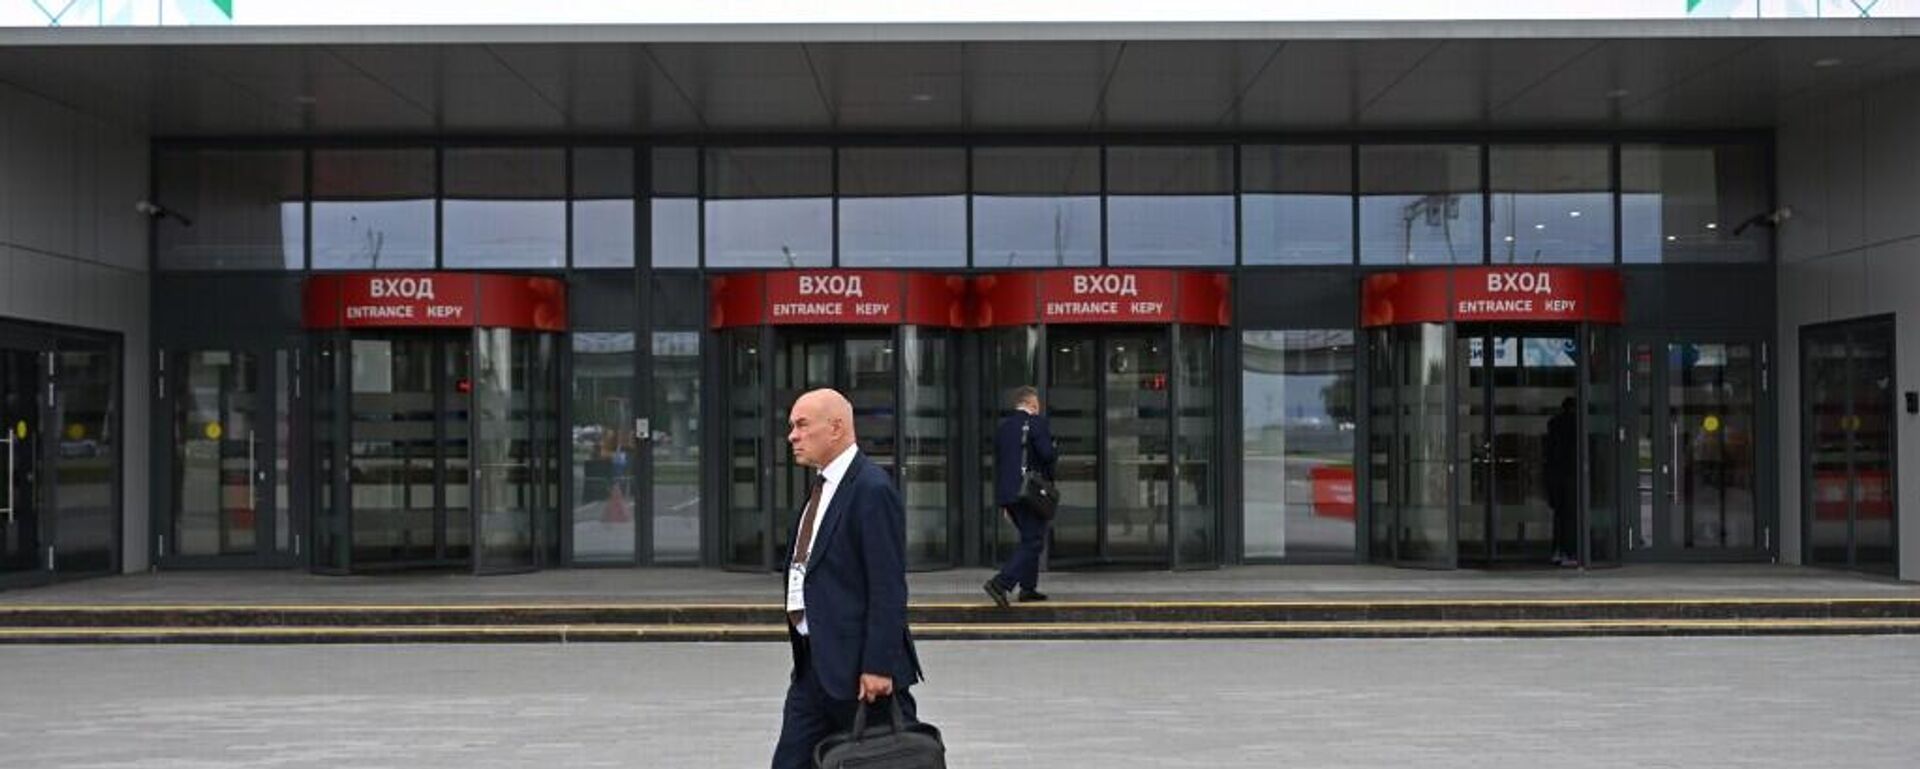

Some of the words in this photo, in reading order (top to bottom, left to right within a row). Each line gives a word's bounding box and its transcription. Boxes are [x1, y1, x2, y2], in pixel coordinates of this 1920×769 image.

[370, 278, 435, 299] ВХОД
[799, 276, 863, 297] ВХОД
[1073, 274, 1138, 296] ВХОД
[1487, 272, 1552, 294] ВХОД
[347, 306, 414, 318] ENTRANCE
[773, 303, 843, 315] ENTRANCE
[1046, 302, 1119, 314] ENTRANCE
[1458, 300, 1533, 312] ENTRANCE
